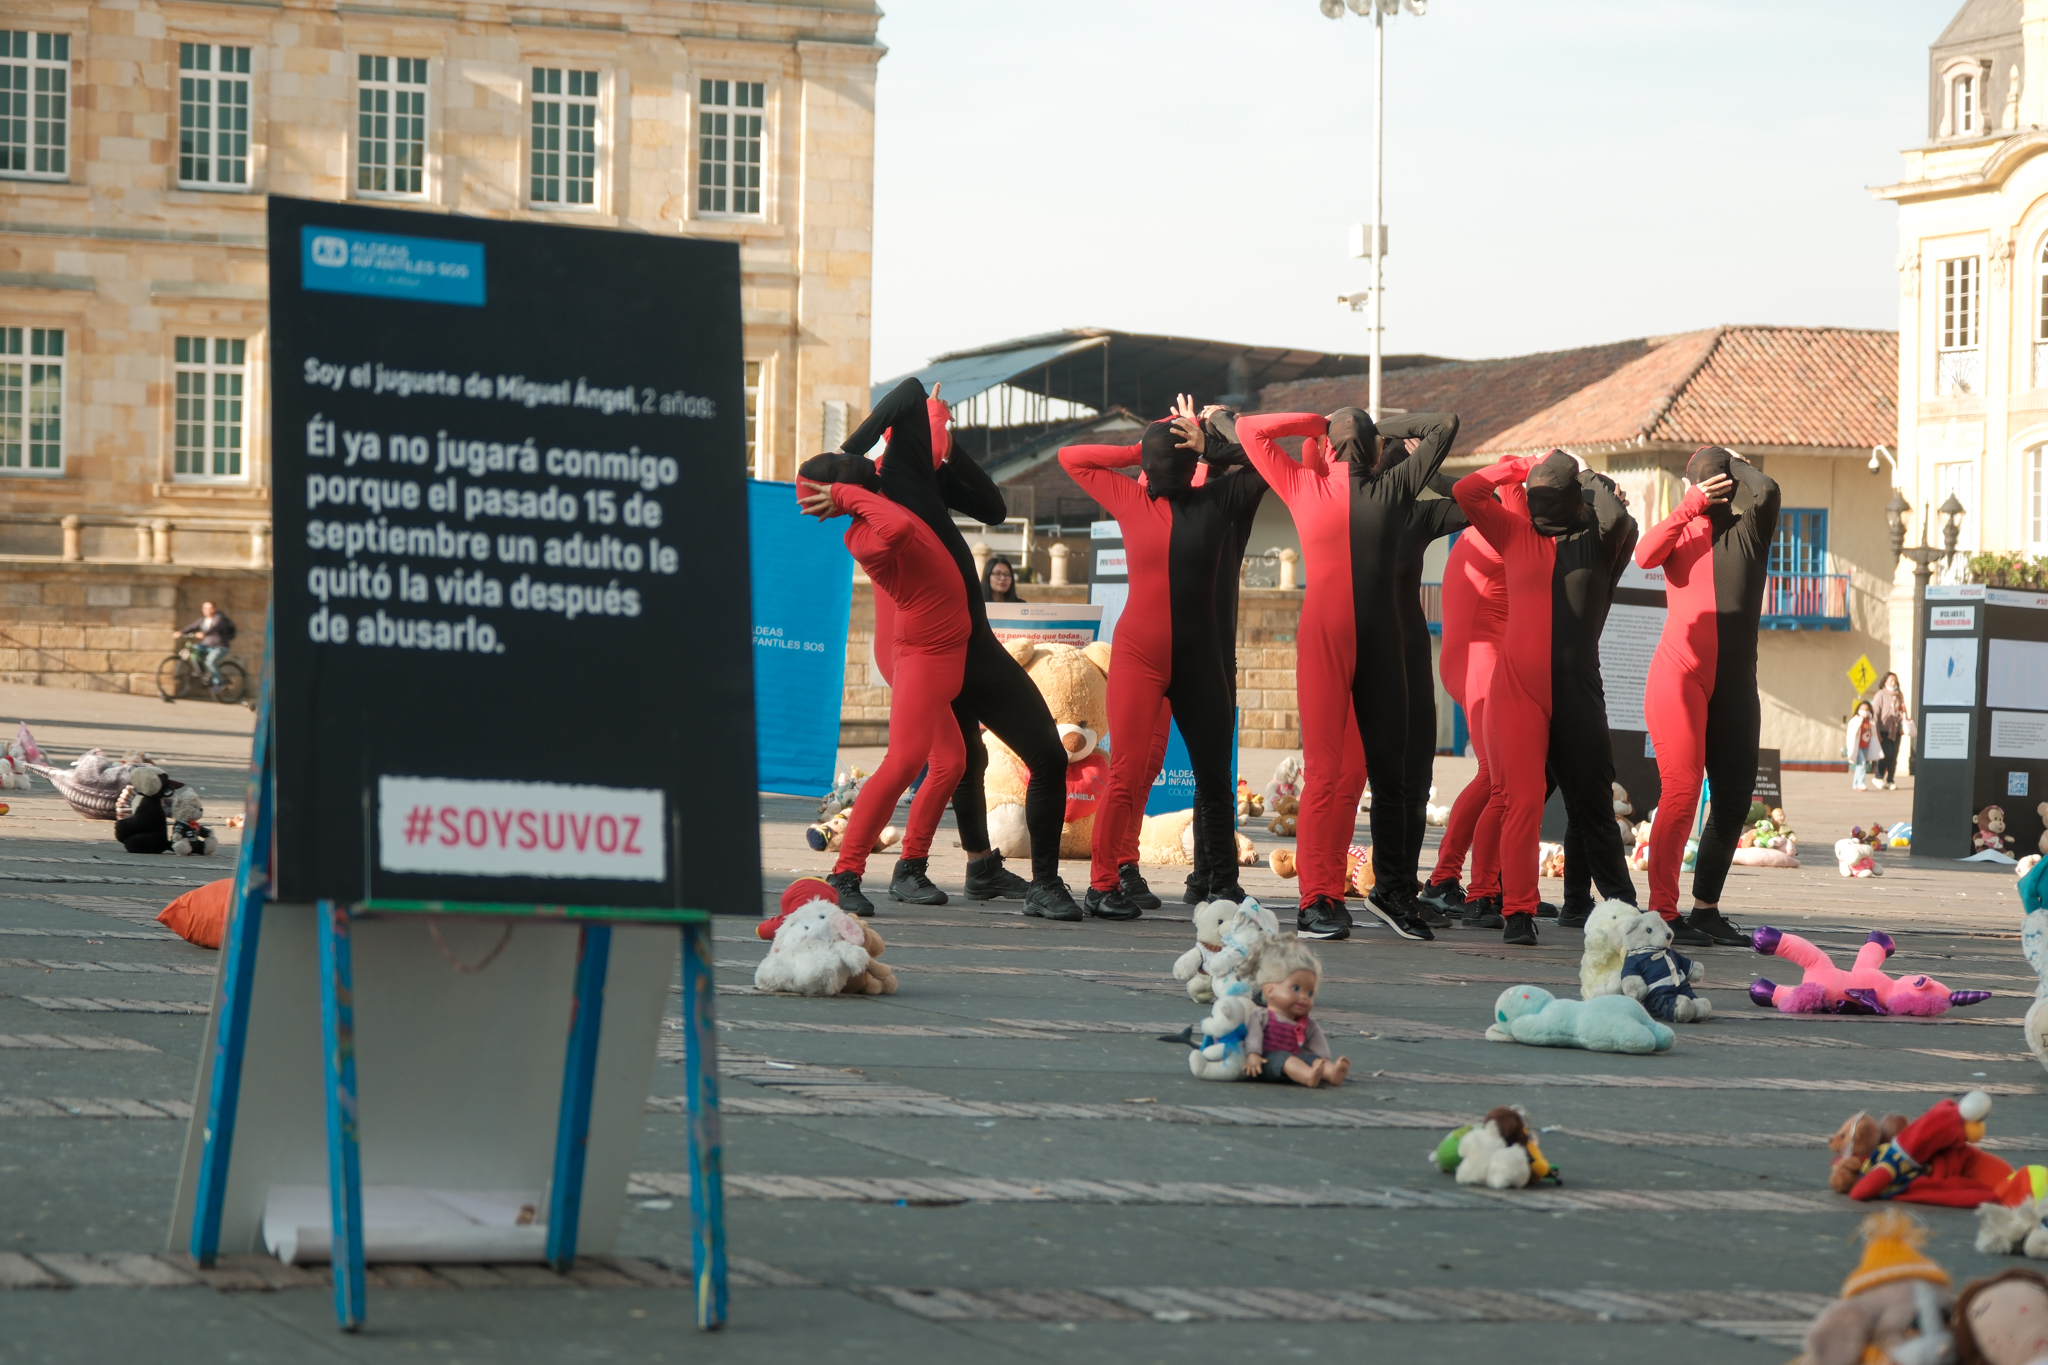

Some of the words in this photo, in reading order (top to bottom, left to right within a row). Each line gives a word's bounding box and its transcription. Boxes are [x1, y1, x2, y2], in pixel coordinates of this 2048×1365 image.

[303, 356, 346, 391] Soy
[349, 361, 371, 388] el
[373, 362, 461, 397] juguete
[464, 371, 494, 399] de
[496, 374, 571, 409] Miguel
[641, 387, 657, 414] 2
[307, 413, 336, 456] Él
[342, 432, 381, 465] ya
[390, 434, 429, 465] no
[434, 431, 539, 477] jugará
[546, 447, 679, 490] conmigo
[307, 474, 421, 514] porque
[428, 478, 457, 512] el
[465, 486, 578, 521] pasado
[584, 489, 617, 524] 15
[623, 492, 662, 528] de
[307, 516, 491, 560] septiembre
[498, 534, 538, 564] un
[544, 532, 644, 571] adulto
[650, 538, 679, 574] le
[308, 561, 392, 603] quitó
[400, 565, 429, 601] la
[436, 568, 503, 607] vida
[510, 573, 641, 619] después
[309, 606, 349, 643] de
[357, 610, 505, 653] abusarlo.
[752, 636, 800, 650] FANTILES
[803, 641, 825, 652] SOS
[1006, 632, 1040, 640] pensado
[1067, 792, 1095, 801] ANIELA
[1168, 769, 1195, 778] ALDEA
[1168, 777, 1196, 787] INFANT
[403, 805, 642, 855] #SOYSUVOZ
